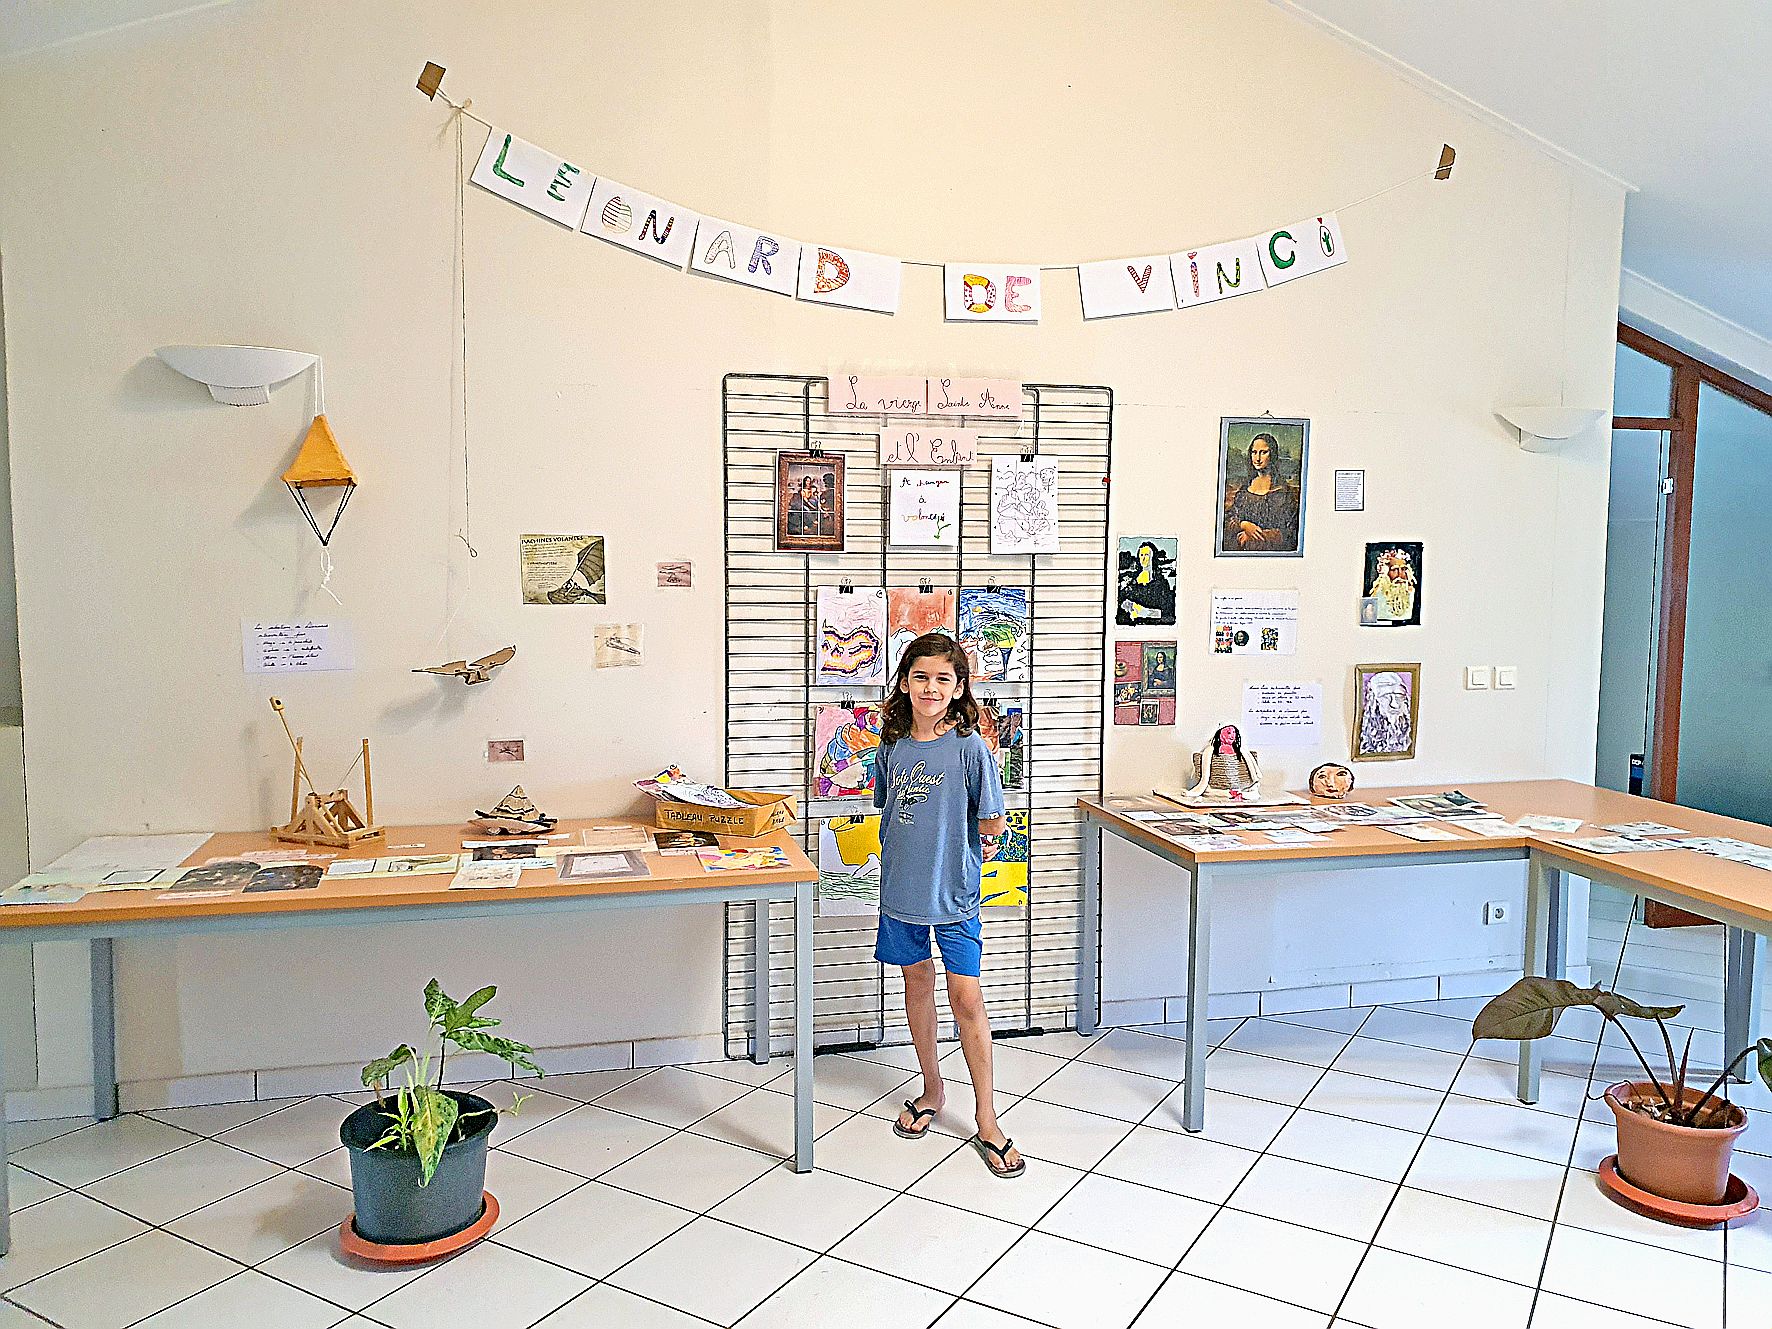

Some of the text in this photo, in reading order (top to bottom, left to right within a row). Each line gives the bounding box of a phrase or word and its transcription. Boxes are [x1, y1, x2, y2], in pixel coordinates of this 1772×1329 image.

[963, 273, 1033, 314] DE
[846, 376, 868, 410] La
[521, 537, 553, 545] MACHINES
[663, 808, 744, 825] TABLEAU PUZZLE
